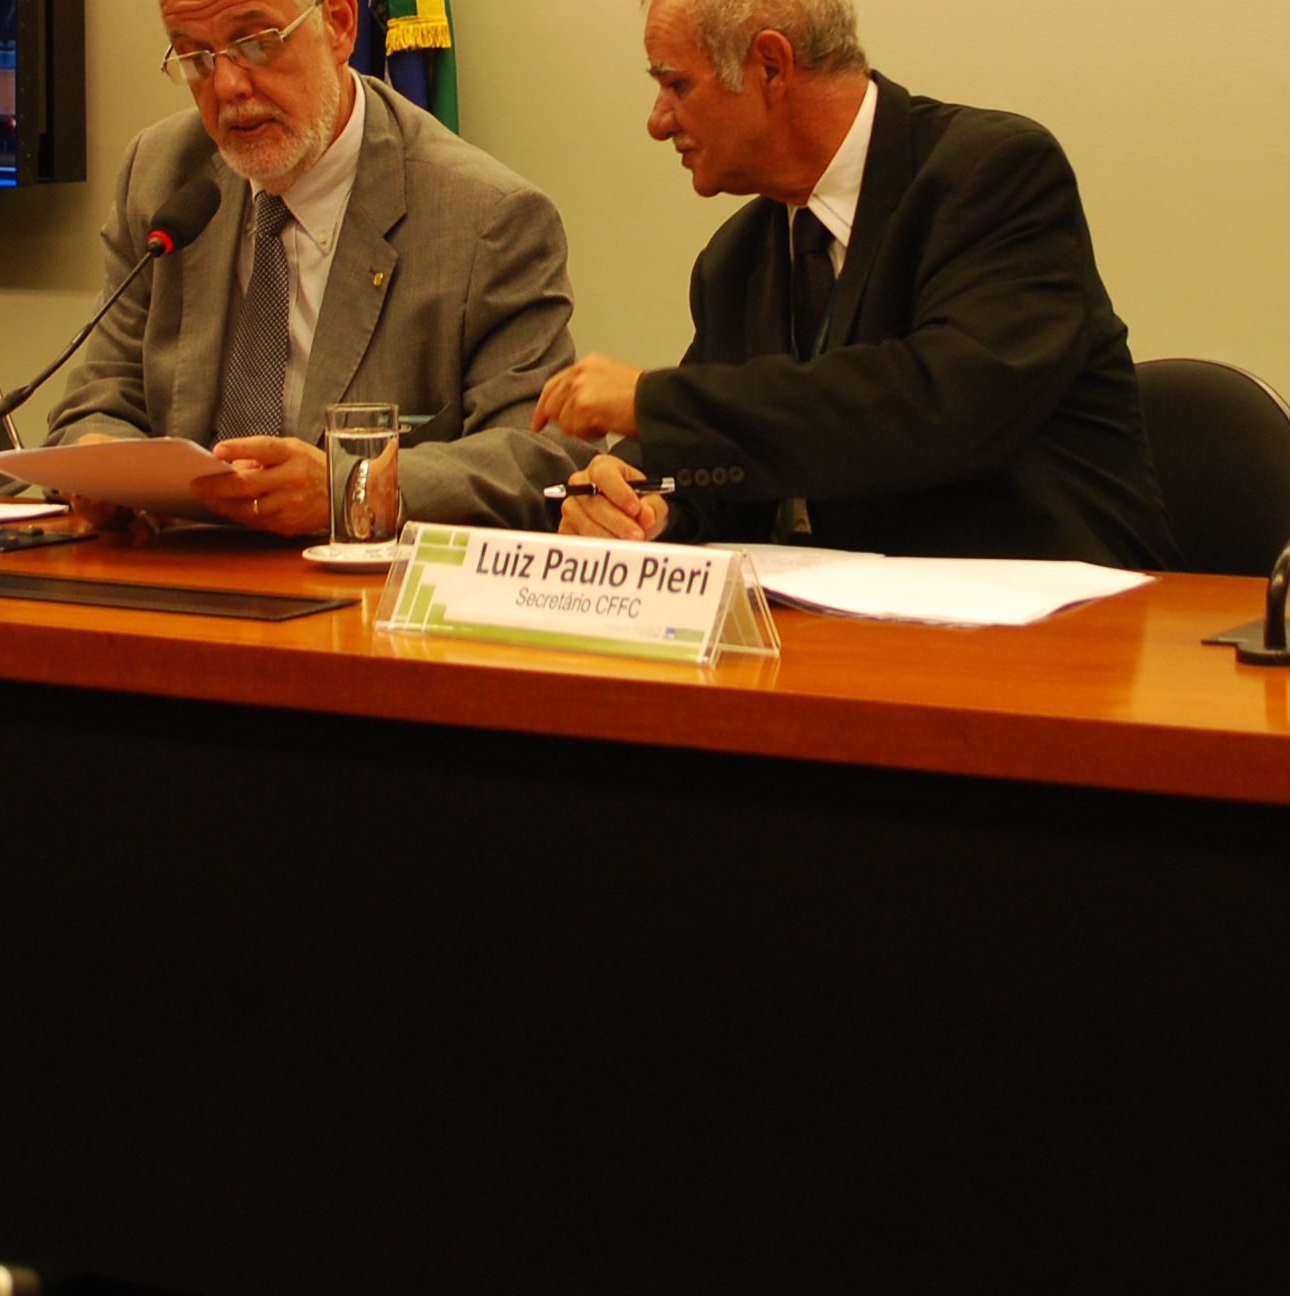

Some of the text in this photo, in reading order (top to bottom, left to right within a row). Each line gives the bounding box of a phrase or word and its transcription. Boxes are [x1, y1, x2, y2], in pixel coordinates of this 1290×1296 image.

[475, 542, 713, 597] Luiz Paulo Pieri
[515, 587, 642, 620] Secretário CFFC
